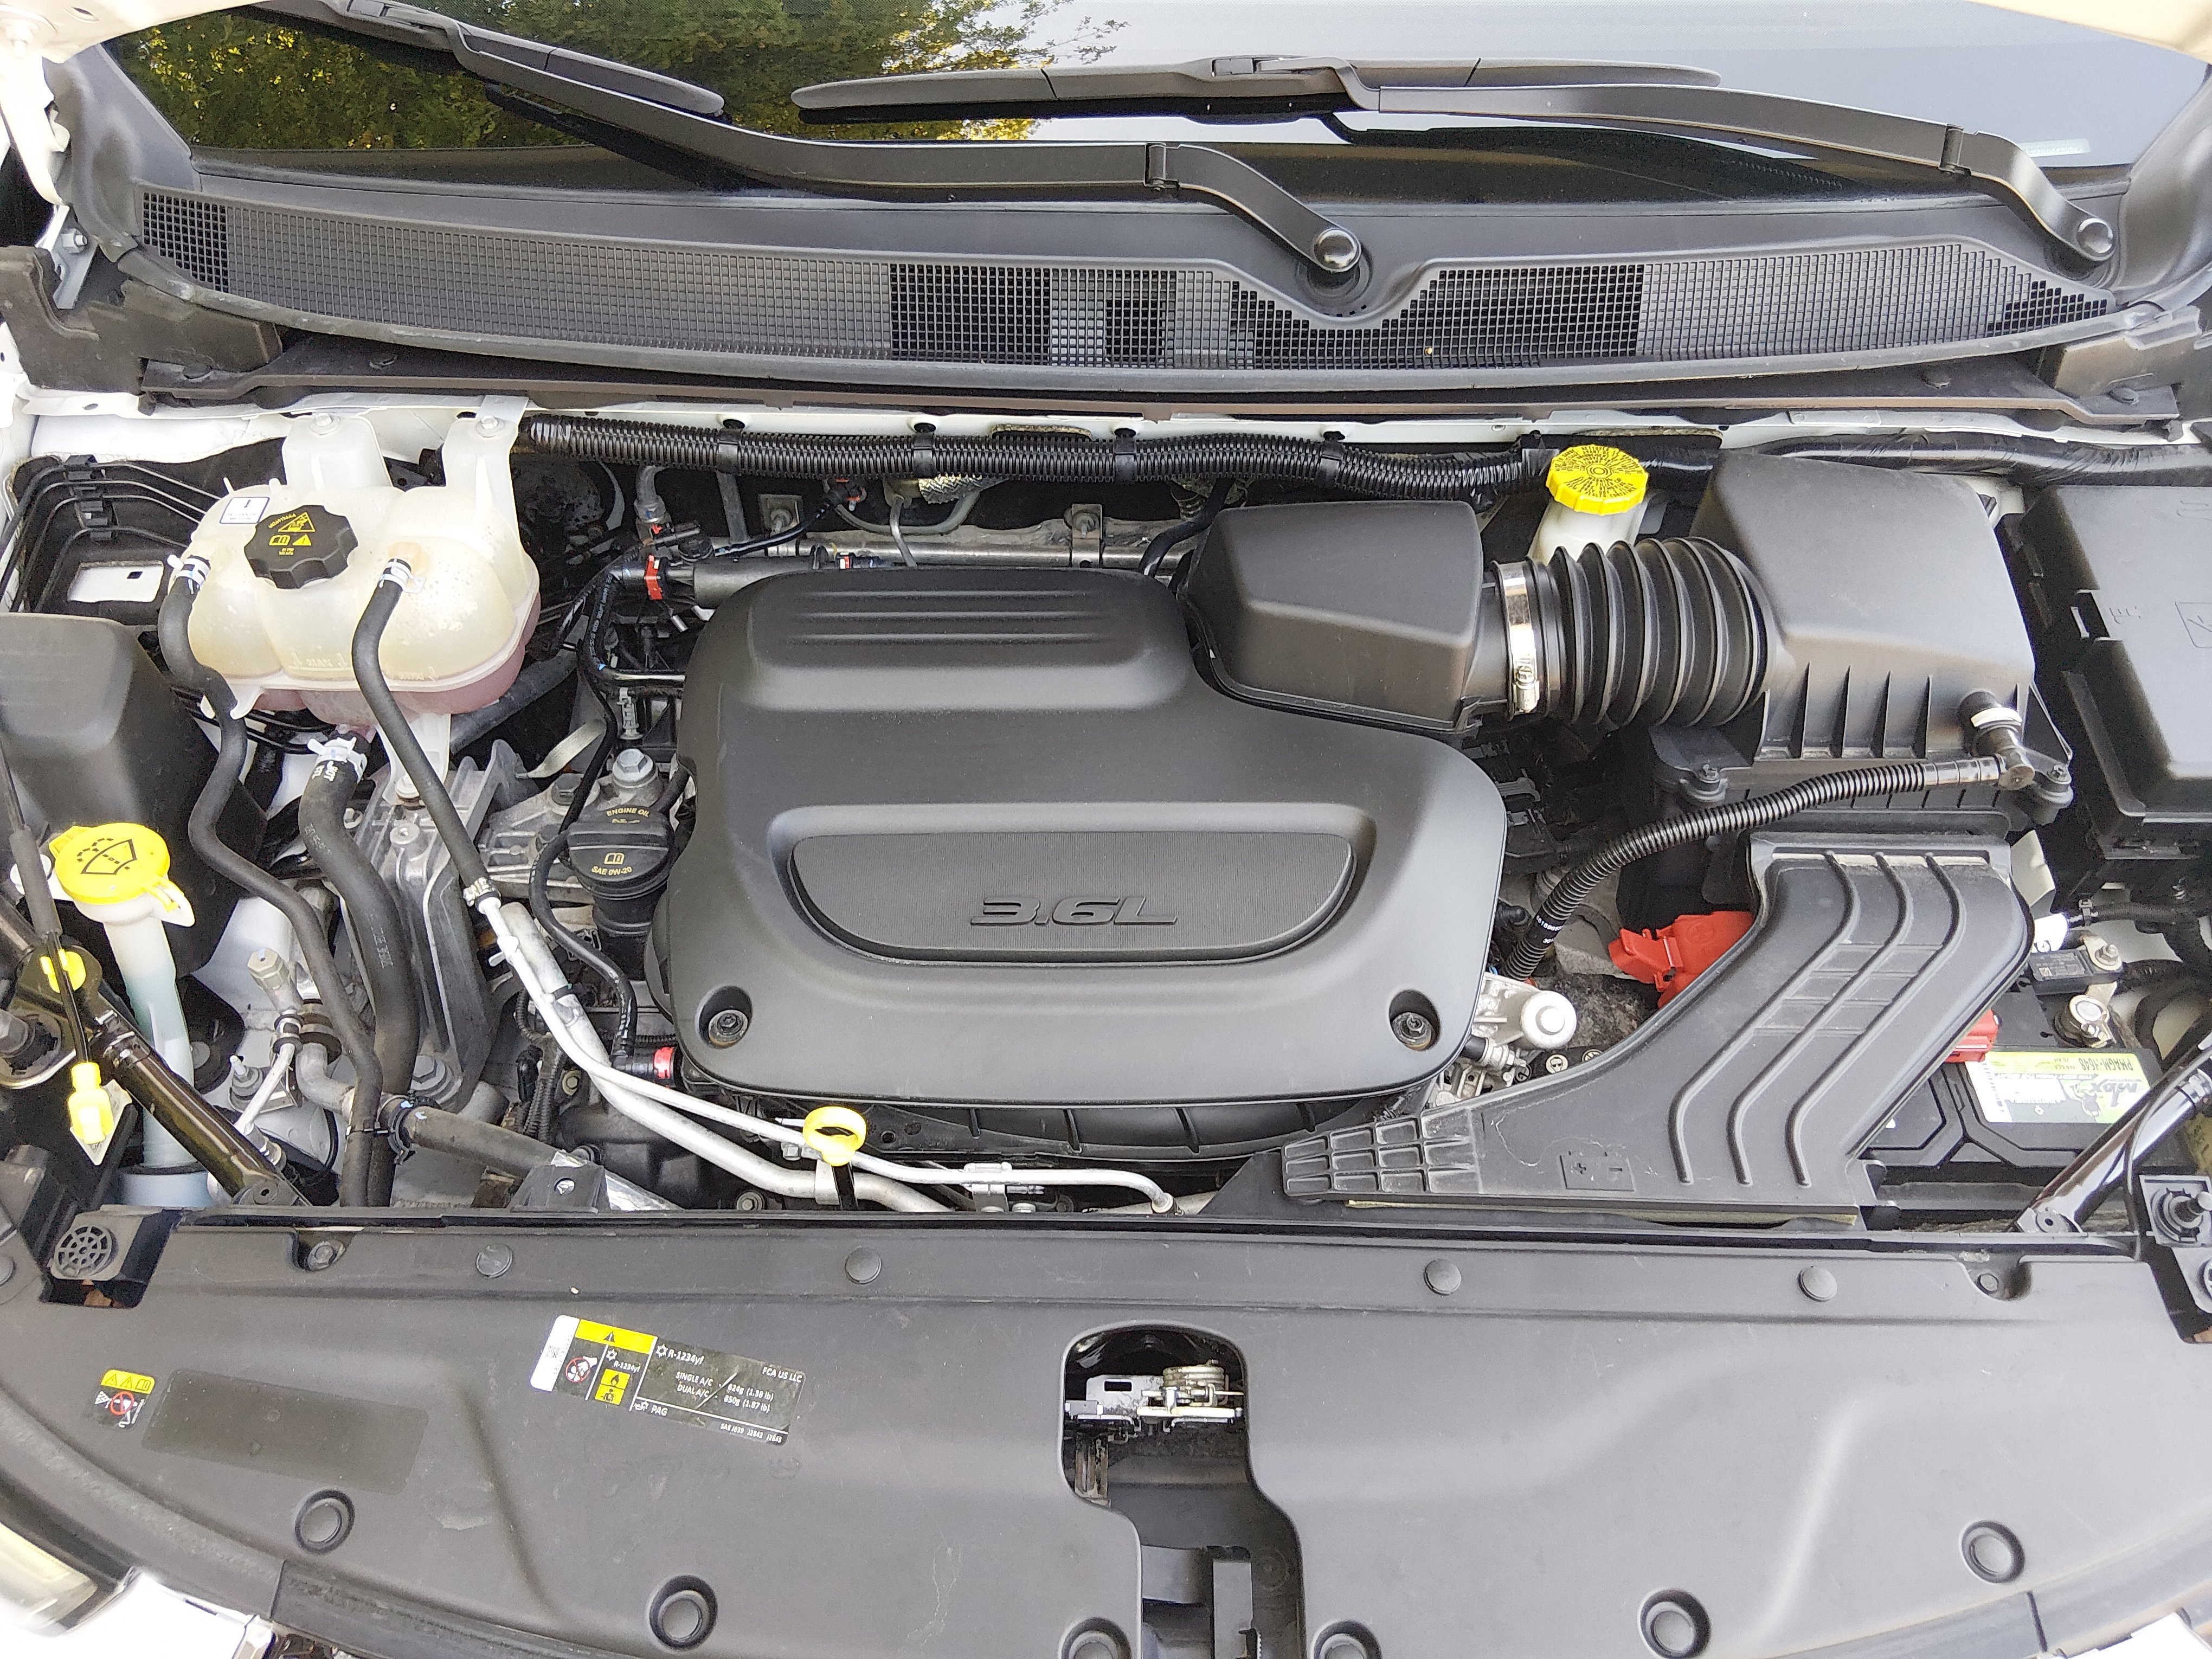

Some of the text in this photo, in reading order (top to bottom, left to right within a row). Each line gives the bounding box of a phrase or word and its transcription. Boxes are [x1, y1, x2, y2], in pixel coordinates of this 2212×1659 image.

[606, 808, 650, 818] ENGINE OIL
[591, 866, 632, 876] SAE 0W-20
[970, 895, 1178, 926] 3.6L
[667, 1348, 705, 1366] R-1234yf
[613, 1360, 641, 1373] R-1234yf
[762, 1366, 802, 1383] FCA US LLC
[676, 1371, 700, 1383] SINGLE
[699, 1377, 713, 1386] A/C
[728, 1383, 744, 1395] 624g
[764, 1391, 774, 1402] lb)
[677, 1384, 695, 1395] DUAL
[695, 1388, 710, 1398] A/C
[742, 1398, 760, 1410] (1.87
[760, 1403, 771, 1414] lb)
[651, 1405, 668, 1417] PAG
